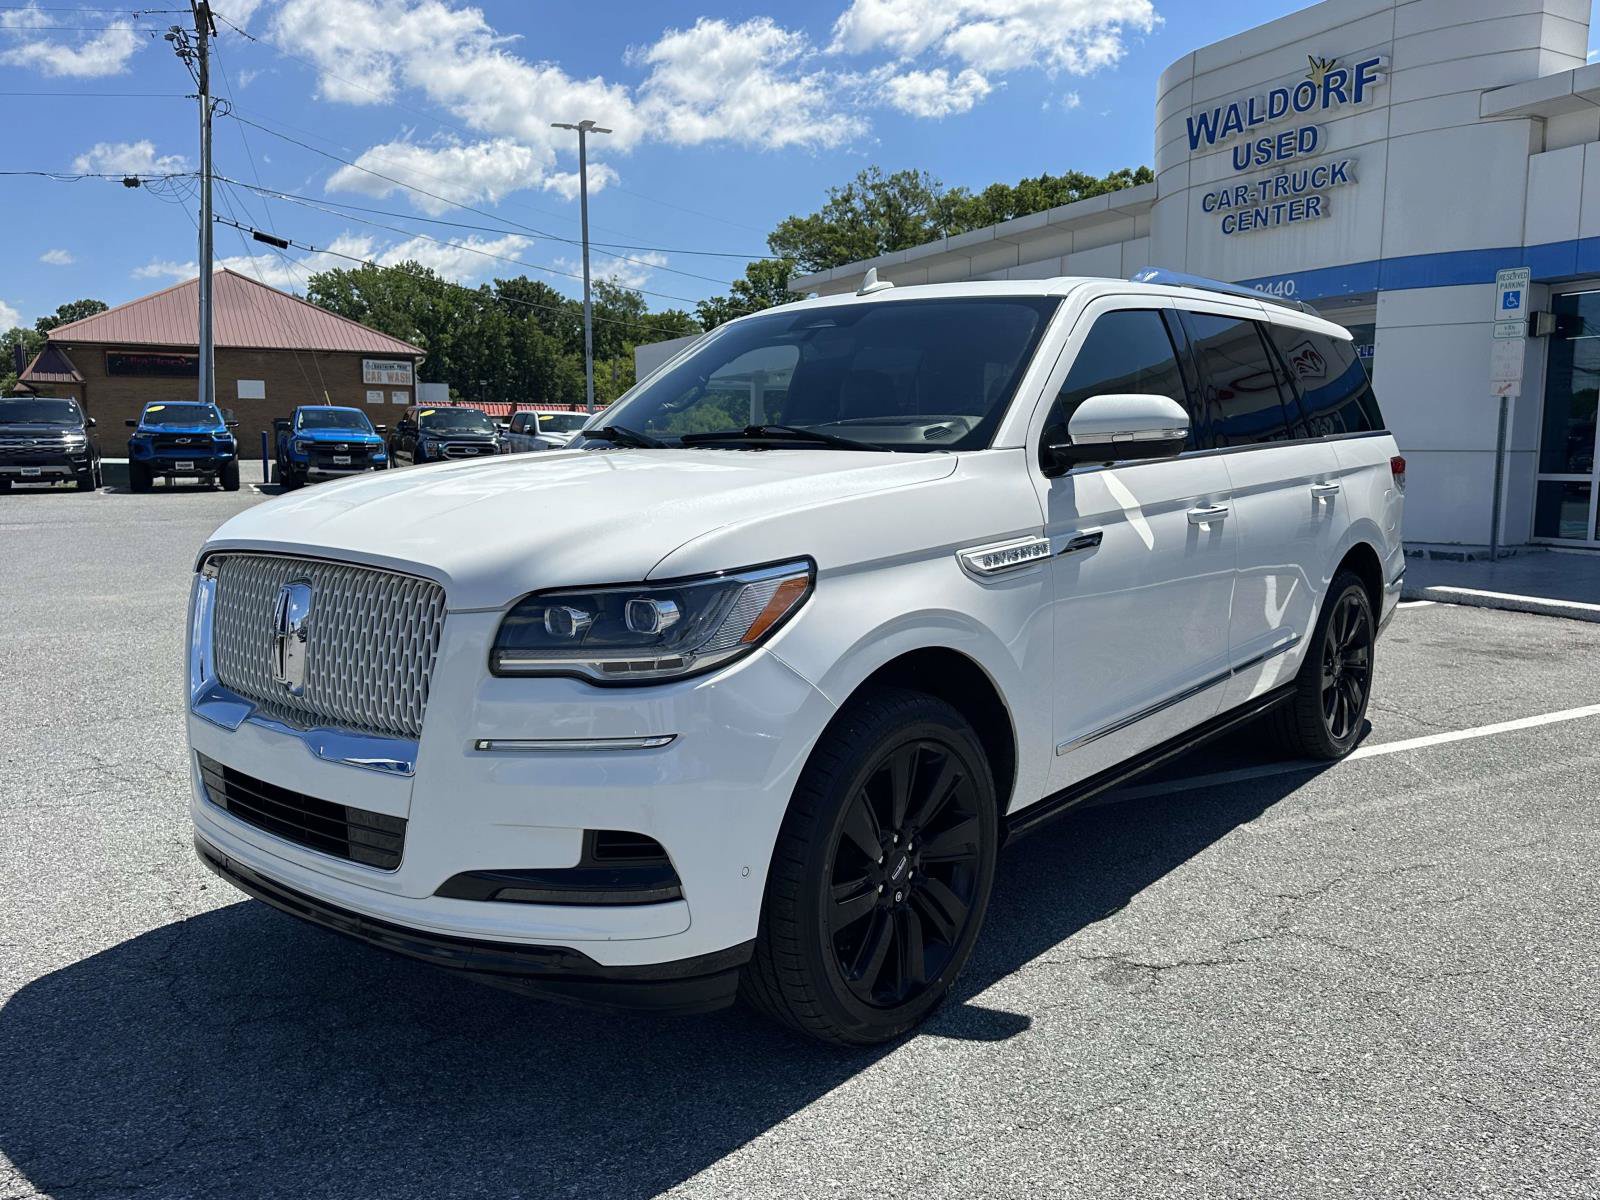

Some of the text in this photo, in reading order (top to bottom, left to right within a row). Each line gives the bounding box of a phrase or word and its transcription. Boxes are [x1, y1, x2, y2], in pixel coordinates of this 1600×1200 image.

[1186, 56, 1380, 151] WALDORF
[1232, 125, 1319, 171] USED
[1202, 160, 1350, 213] CAR-TRUCK
[1221, 195, 1321, 235] CENTER
[1500, 271, 1527, 280] RESERVED
[1500, 281, 1526, 289] PARKING
[365, 371, 411, 383] CAR WASH
